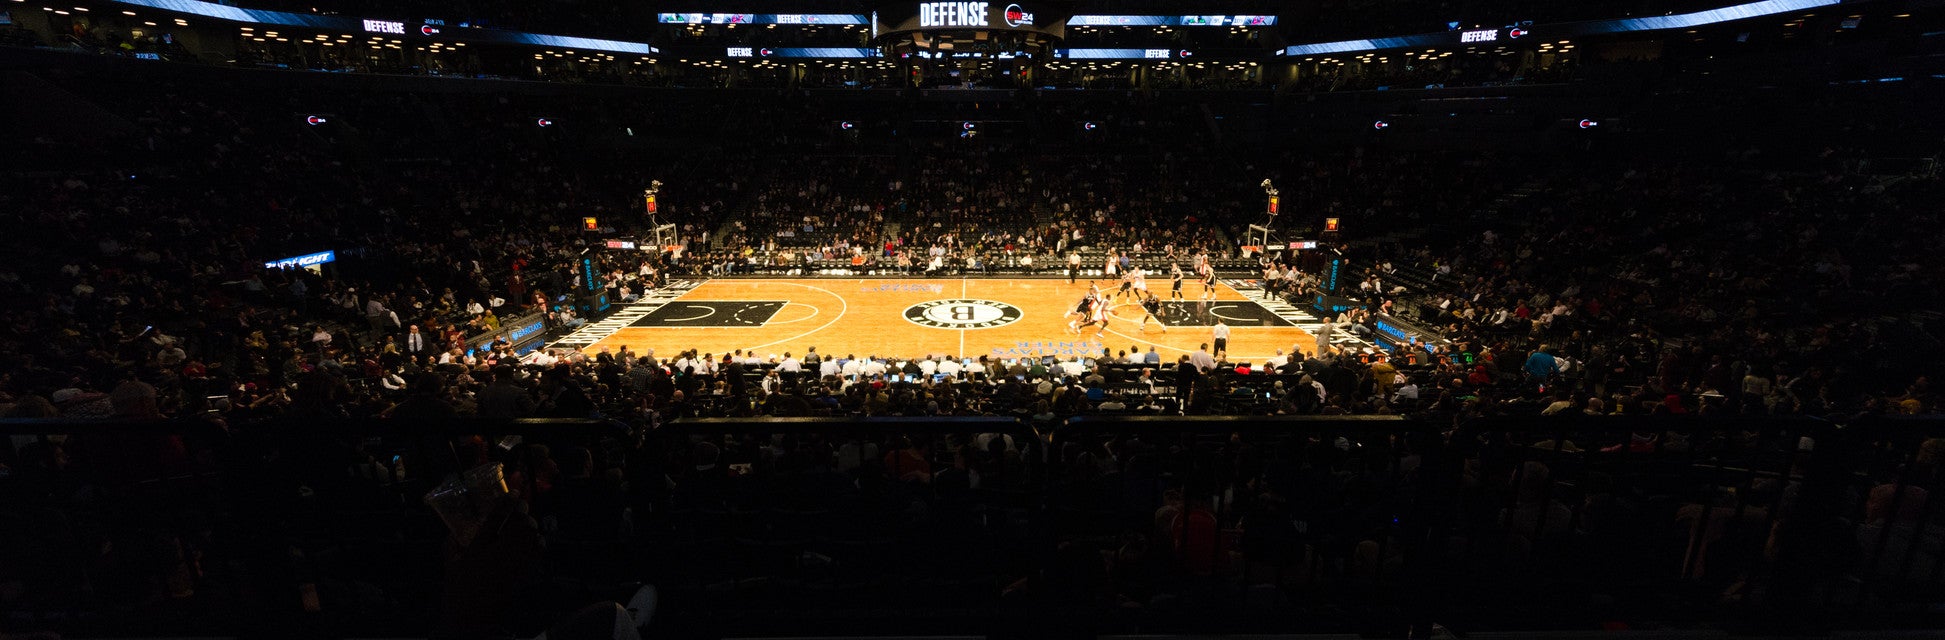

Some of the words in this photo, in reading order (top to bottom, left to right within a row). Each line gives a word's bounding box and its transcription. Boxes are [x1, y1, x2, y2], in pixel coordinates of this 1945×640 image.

[776, 14, 802, 24] DEFENSE
[920, 2, 989, 27] DEFENSE
[1007, 10, 1034, 21] SW24
[363, 19, 406, 34] DEFENSE
[1461, 29, 1498, 43] DEFENSE
[727, 47, 752, 57] DEFENSE
[1145, 49, 1170, 58] DEFENSE
[1289, 241, 1316, 249] SW24
[950, 306, 974, 320] B
[518, 321, 543, 338] BARCLAYS
[1382, 323, 1406, 340] BARCLAYS
